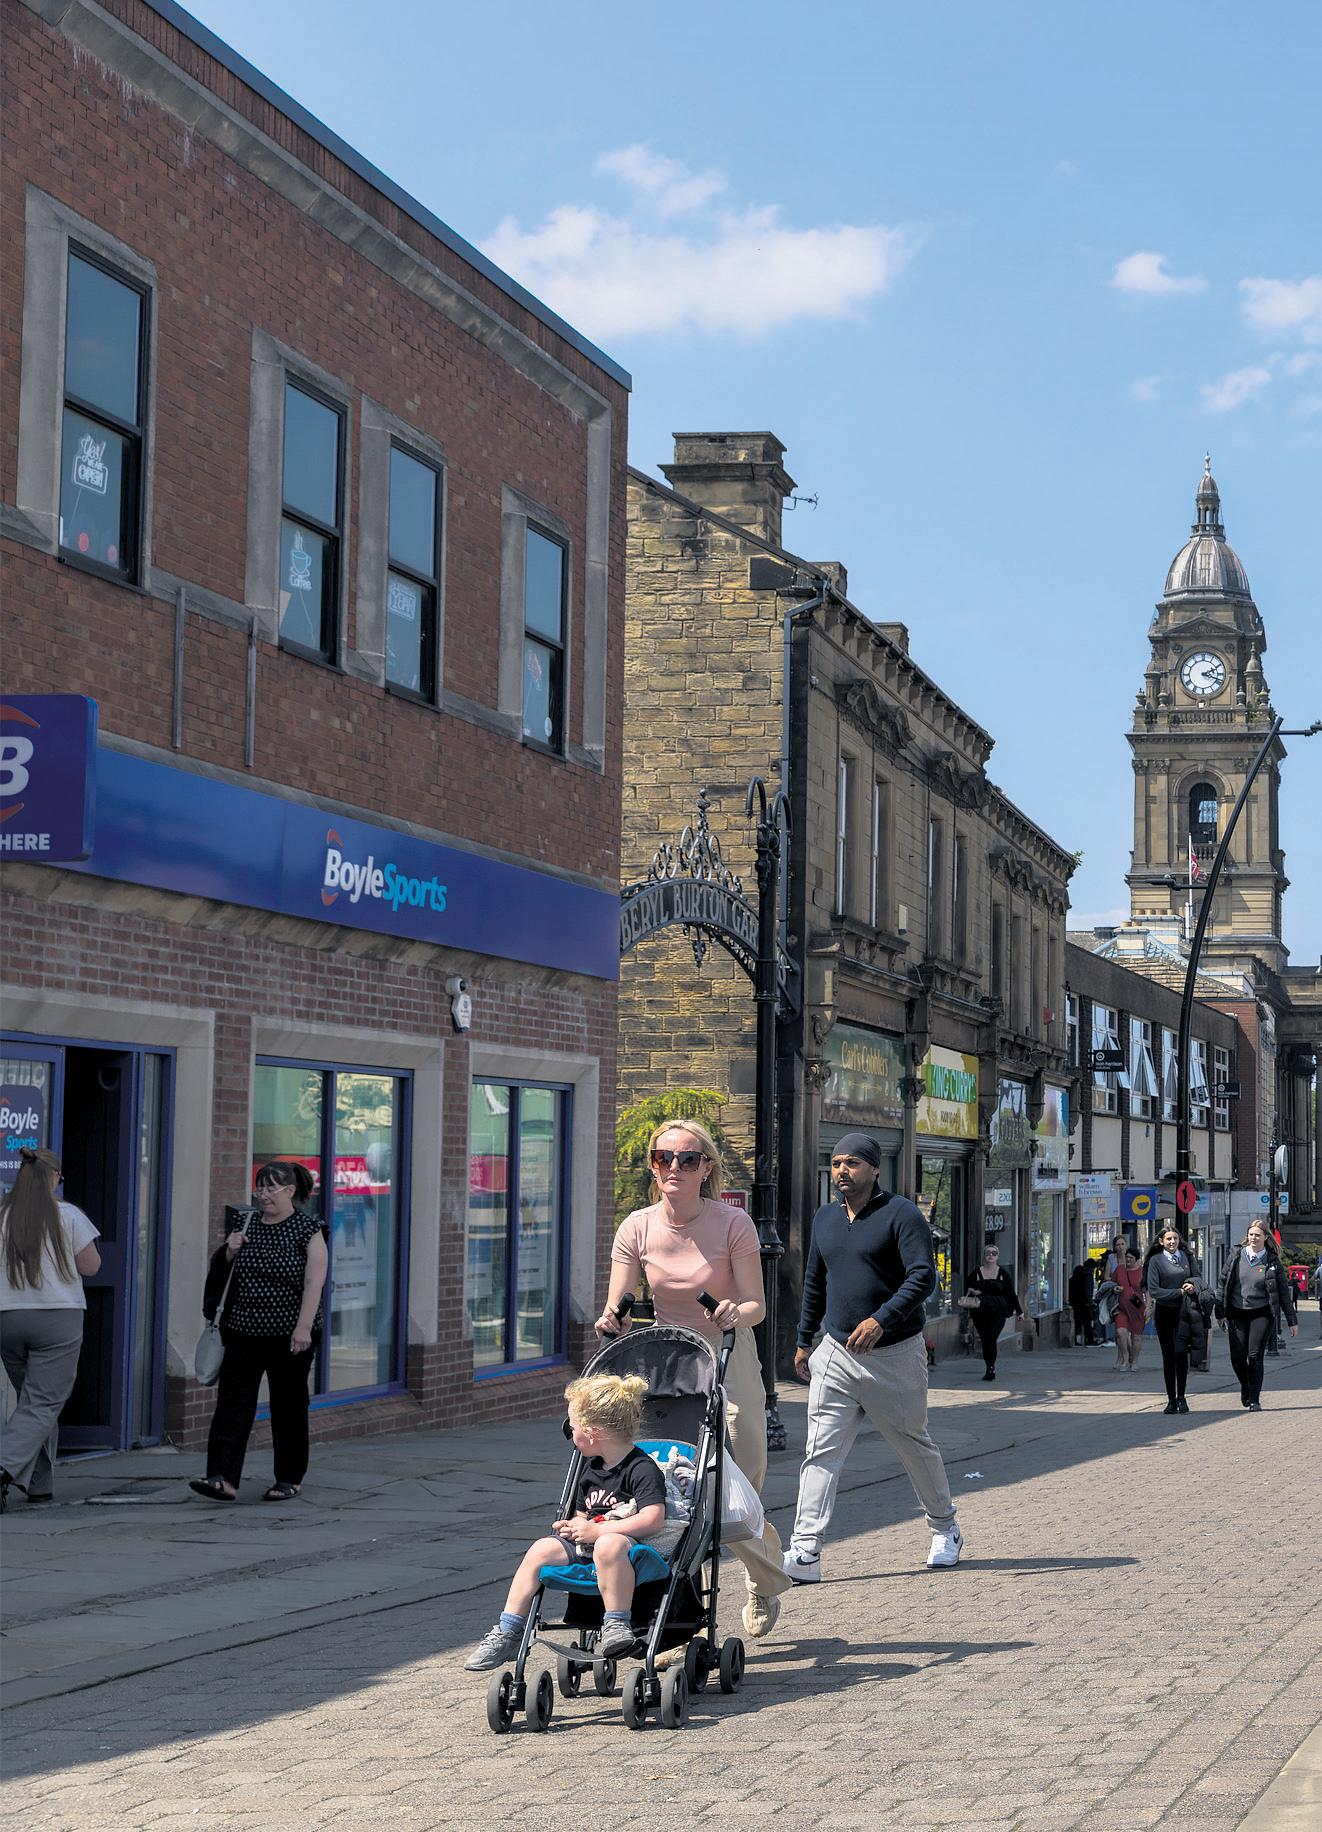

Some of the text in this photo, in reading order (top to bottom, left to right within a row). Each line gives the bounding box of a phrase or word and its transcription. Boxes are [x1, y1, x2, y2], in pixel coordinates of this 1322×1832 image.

[78, 464, 103, 487] OPEN
[324, 848, 447, 912] BoyleSports
[622, 887, 669, 947] BERYL
[674, 884, 729, 926] BURTON
[931, 1065, 950, 1099] KING
[0, 1107, 39, 1135] Boyle
[5, 1135, 38, 1152] Sports
